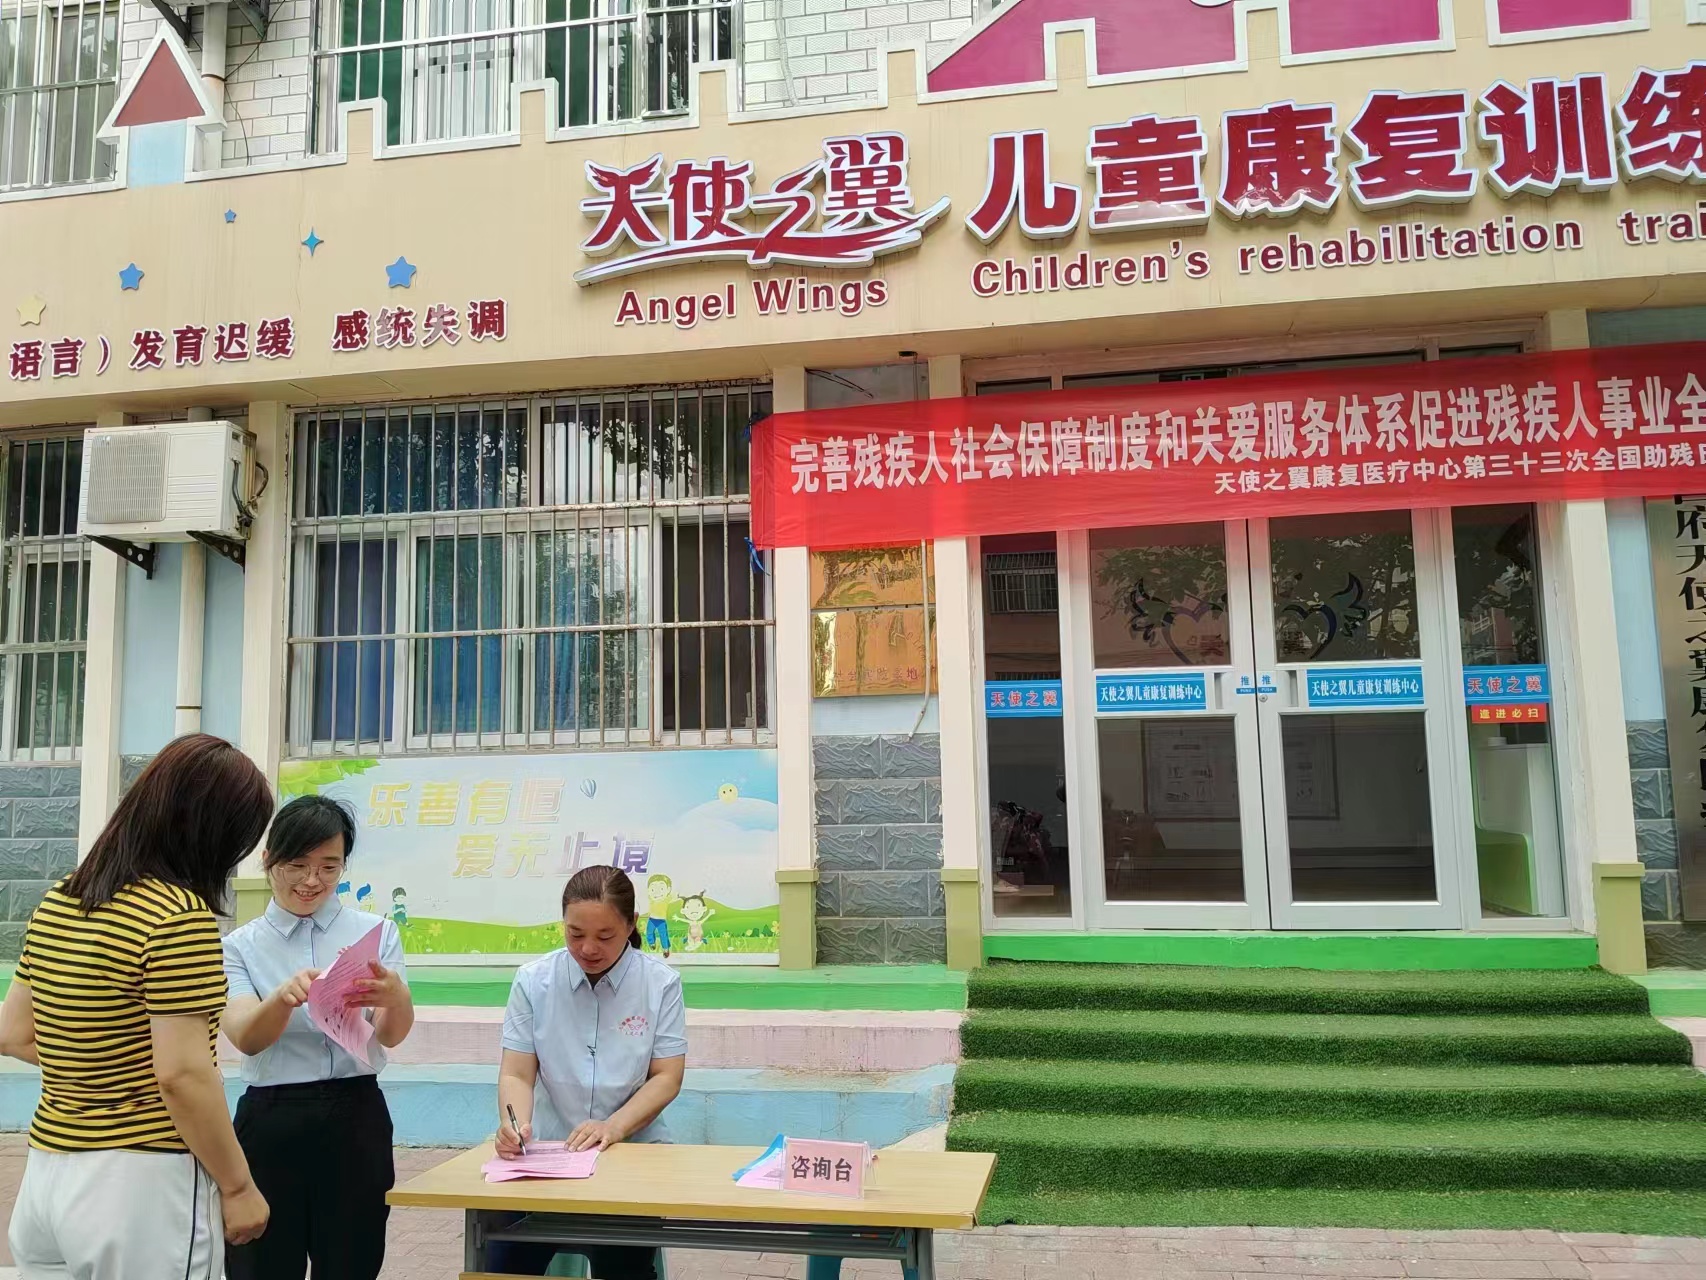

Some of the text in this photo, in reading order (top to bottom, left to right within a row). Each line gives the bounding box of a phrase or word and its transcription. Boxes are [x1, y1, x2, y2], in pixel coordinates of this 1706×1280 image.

[576, 64, 1706, 284] 天使之翼 儿童康复训练
[973, 240, 1210, 297] Children's
[1239, 215, 1583, 274] rehabilitation
[615, 277, 888, 328] Angel Wings
[332, 298, 508, 352] 感统失调
[790, 373, 1706, 494] 完善残疾人社会保障制度和关爱服务体系促进残疾人事业全
[1241, 675, 1250, 686] 推
[1261, 674, 1271, 685] 推
[1311, 678, 1420, 698] 天使之翼儿童康复训练中心
[1467, 675, 1543, 694] 天使之翼
[991, 690, 1058, 708] 天使之翼
[1100, 685, 1202, 703] 天使之翼儿童康复训练中心
[367, 778, 565, 827] 乐善有恒
[791, 1155, 853, 1182] 咨询台
